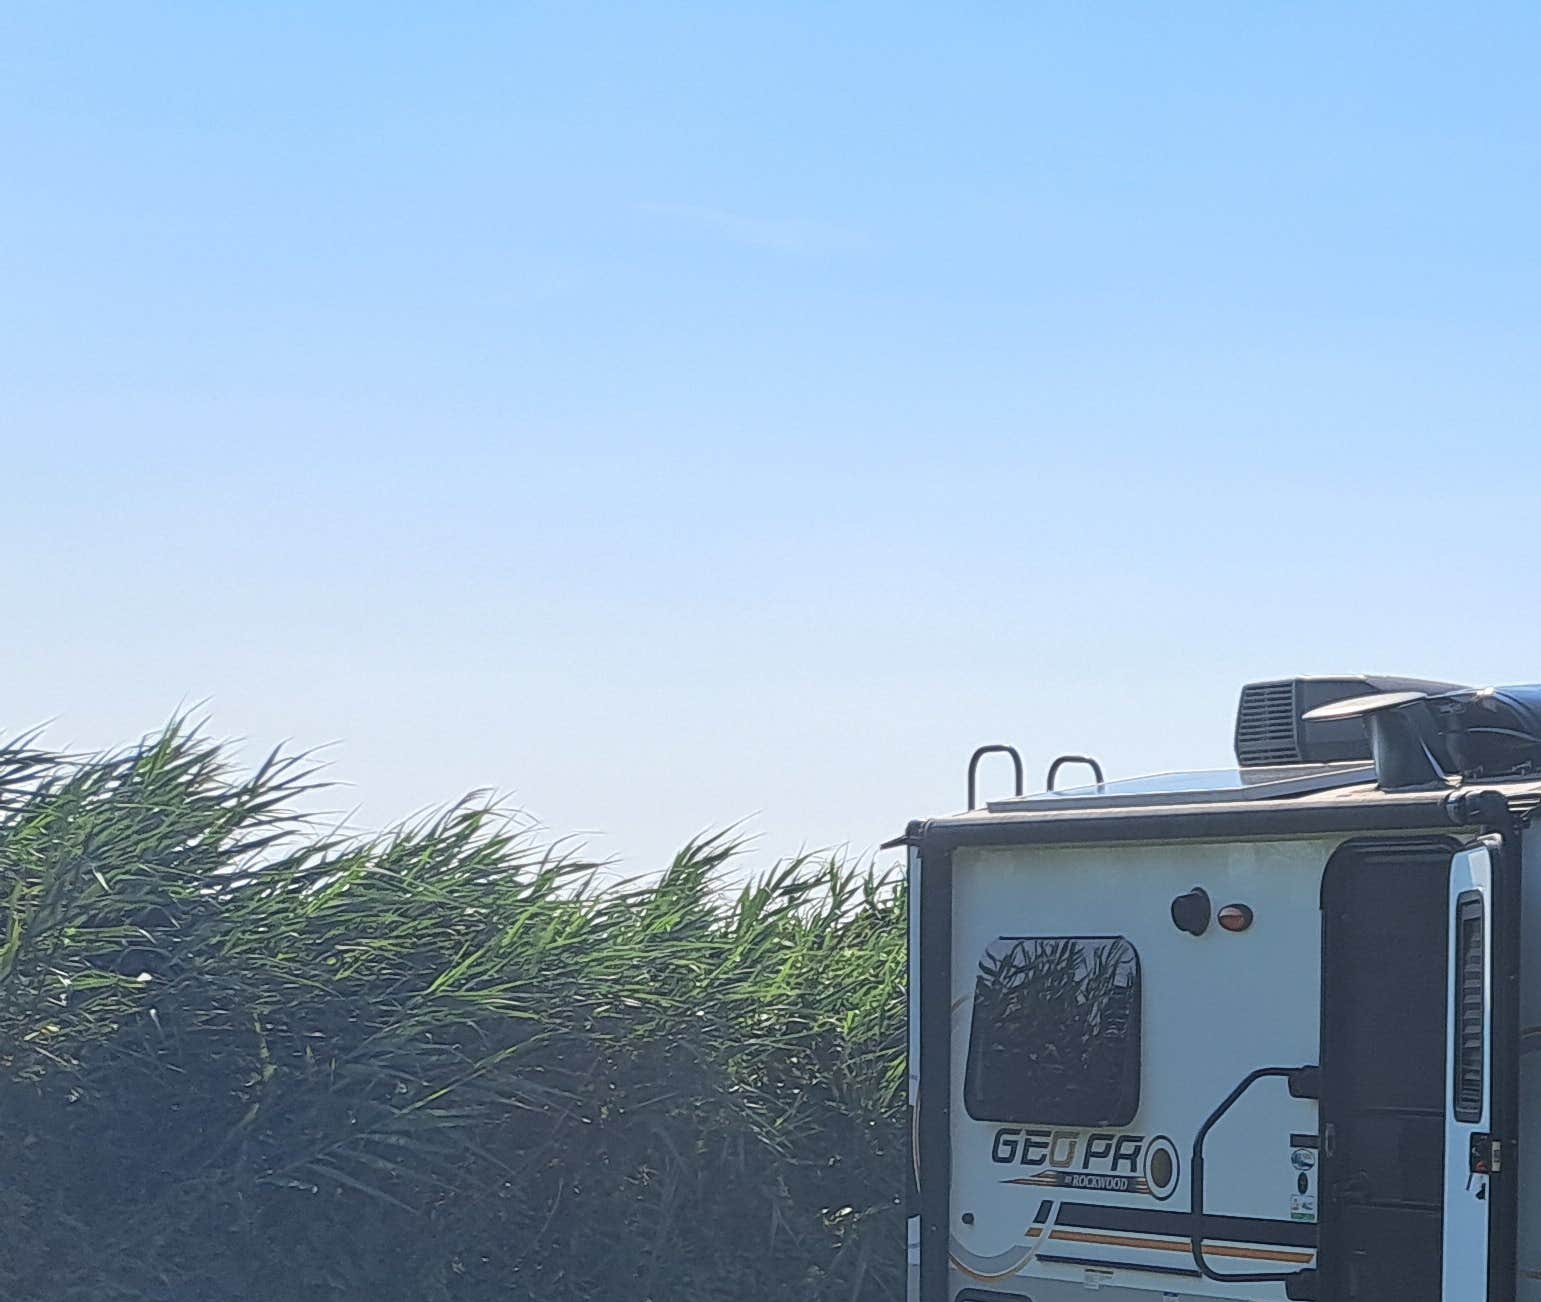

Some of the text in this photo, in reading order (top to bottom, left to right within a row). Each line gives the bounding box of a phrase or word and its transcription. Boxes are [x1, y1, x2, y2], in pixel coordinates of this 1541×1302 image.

[991, 1128, 1181, 1201] GEO PRO
[1072, 1174, 1128, 1191] ROCKWOOD
